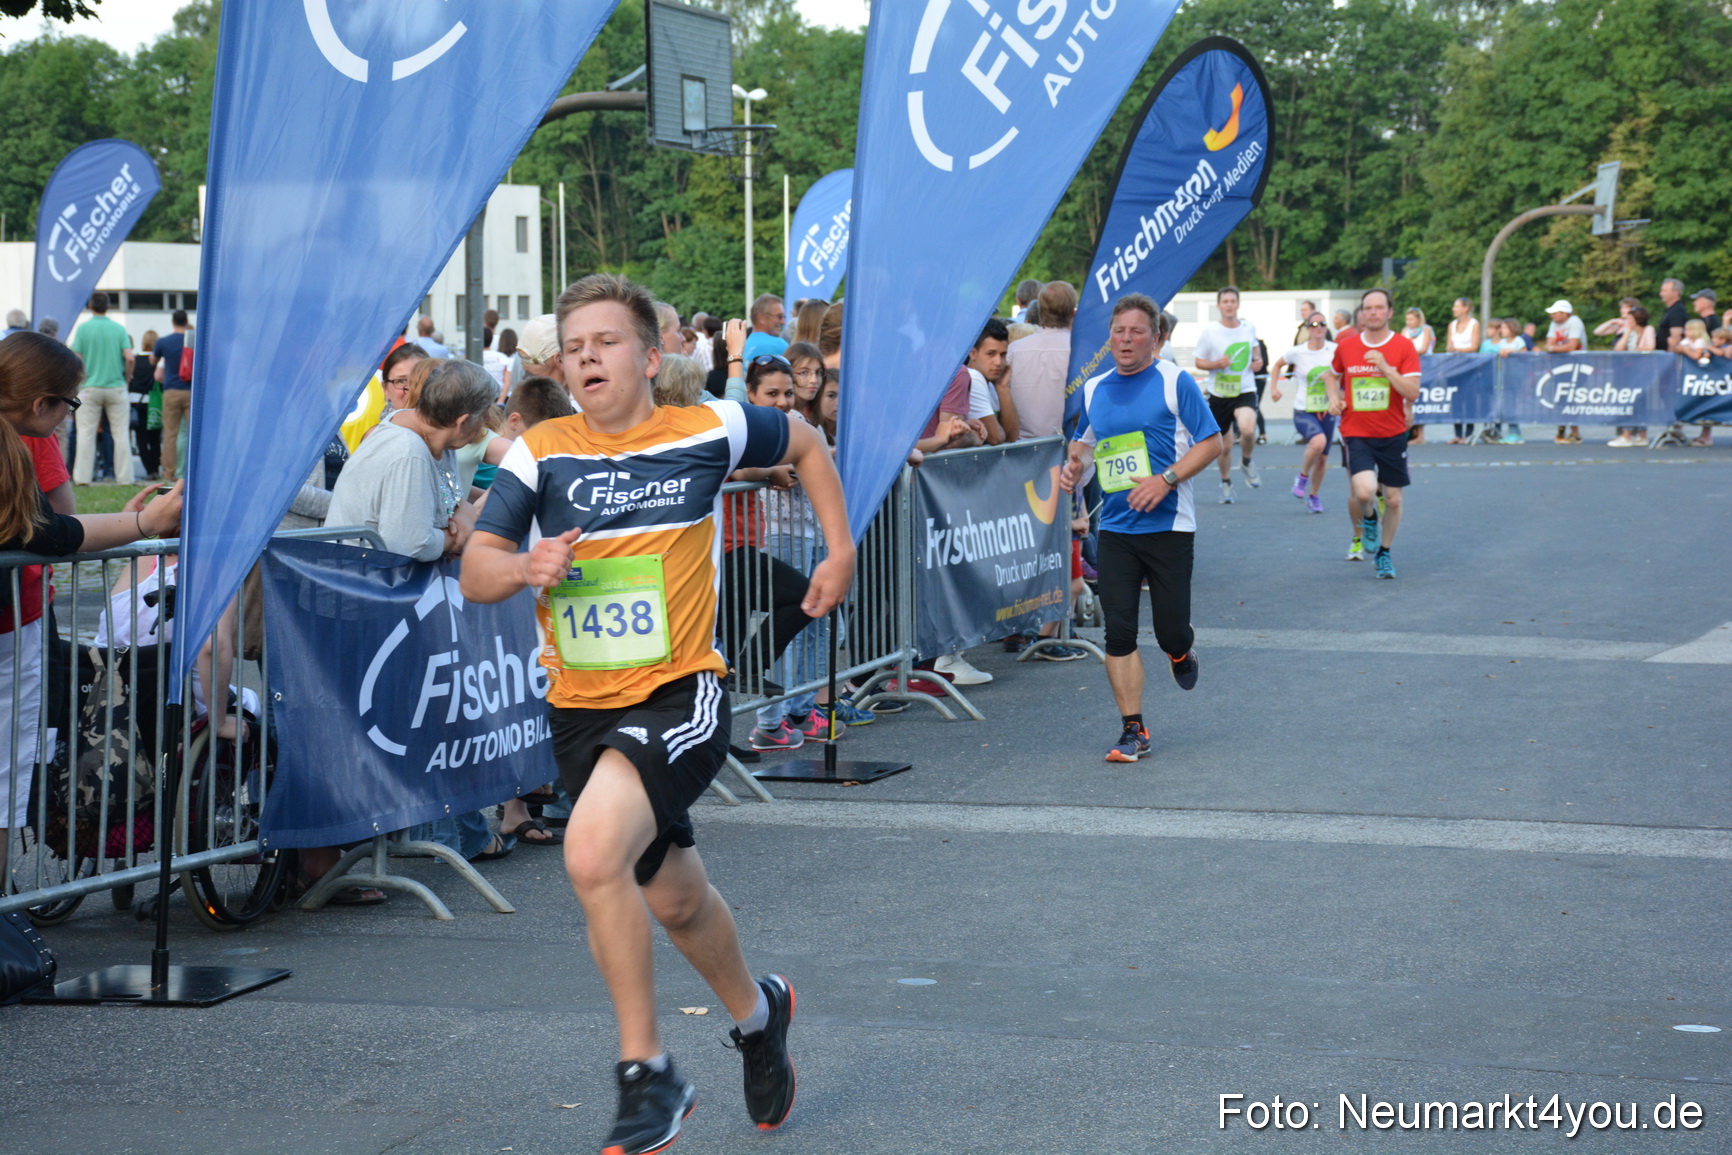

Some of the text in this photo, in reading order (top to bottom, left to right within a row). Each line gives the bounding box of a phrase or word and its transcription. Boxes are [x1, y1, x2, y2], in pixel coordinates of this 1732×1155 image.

[1173, 203, 1205, 244] Druck
[1222, 139, 1263, 192] Medien
[64, 162, 134, 265] Fischer
[87, 181, 142, 264] AUTOMOBILE
[1095, 158, 1218, 304] Frischmann
[1355, 390, 1385, 402] 1421
[1554, 382, 1642, 404] Fischer
[1562, 405, 1634, 416] AUTOMOBILE
[1105, 455, 1138, 477] 796
[600, 496, 685, 516] AUTOMOBILE
[926, 509, 1035, 570] Frischmann
[995, 559, 1020, 586] Druck
[1020, 553, 1038, 580] und
[562, 599, 655, 639] 1438
